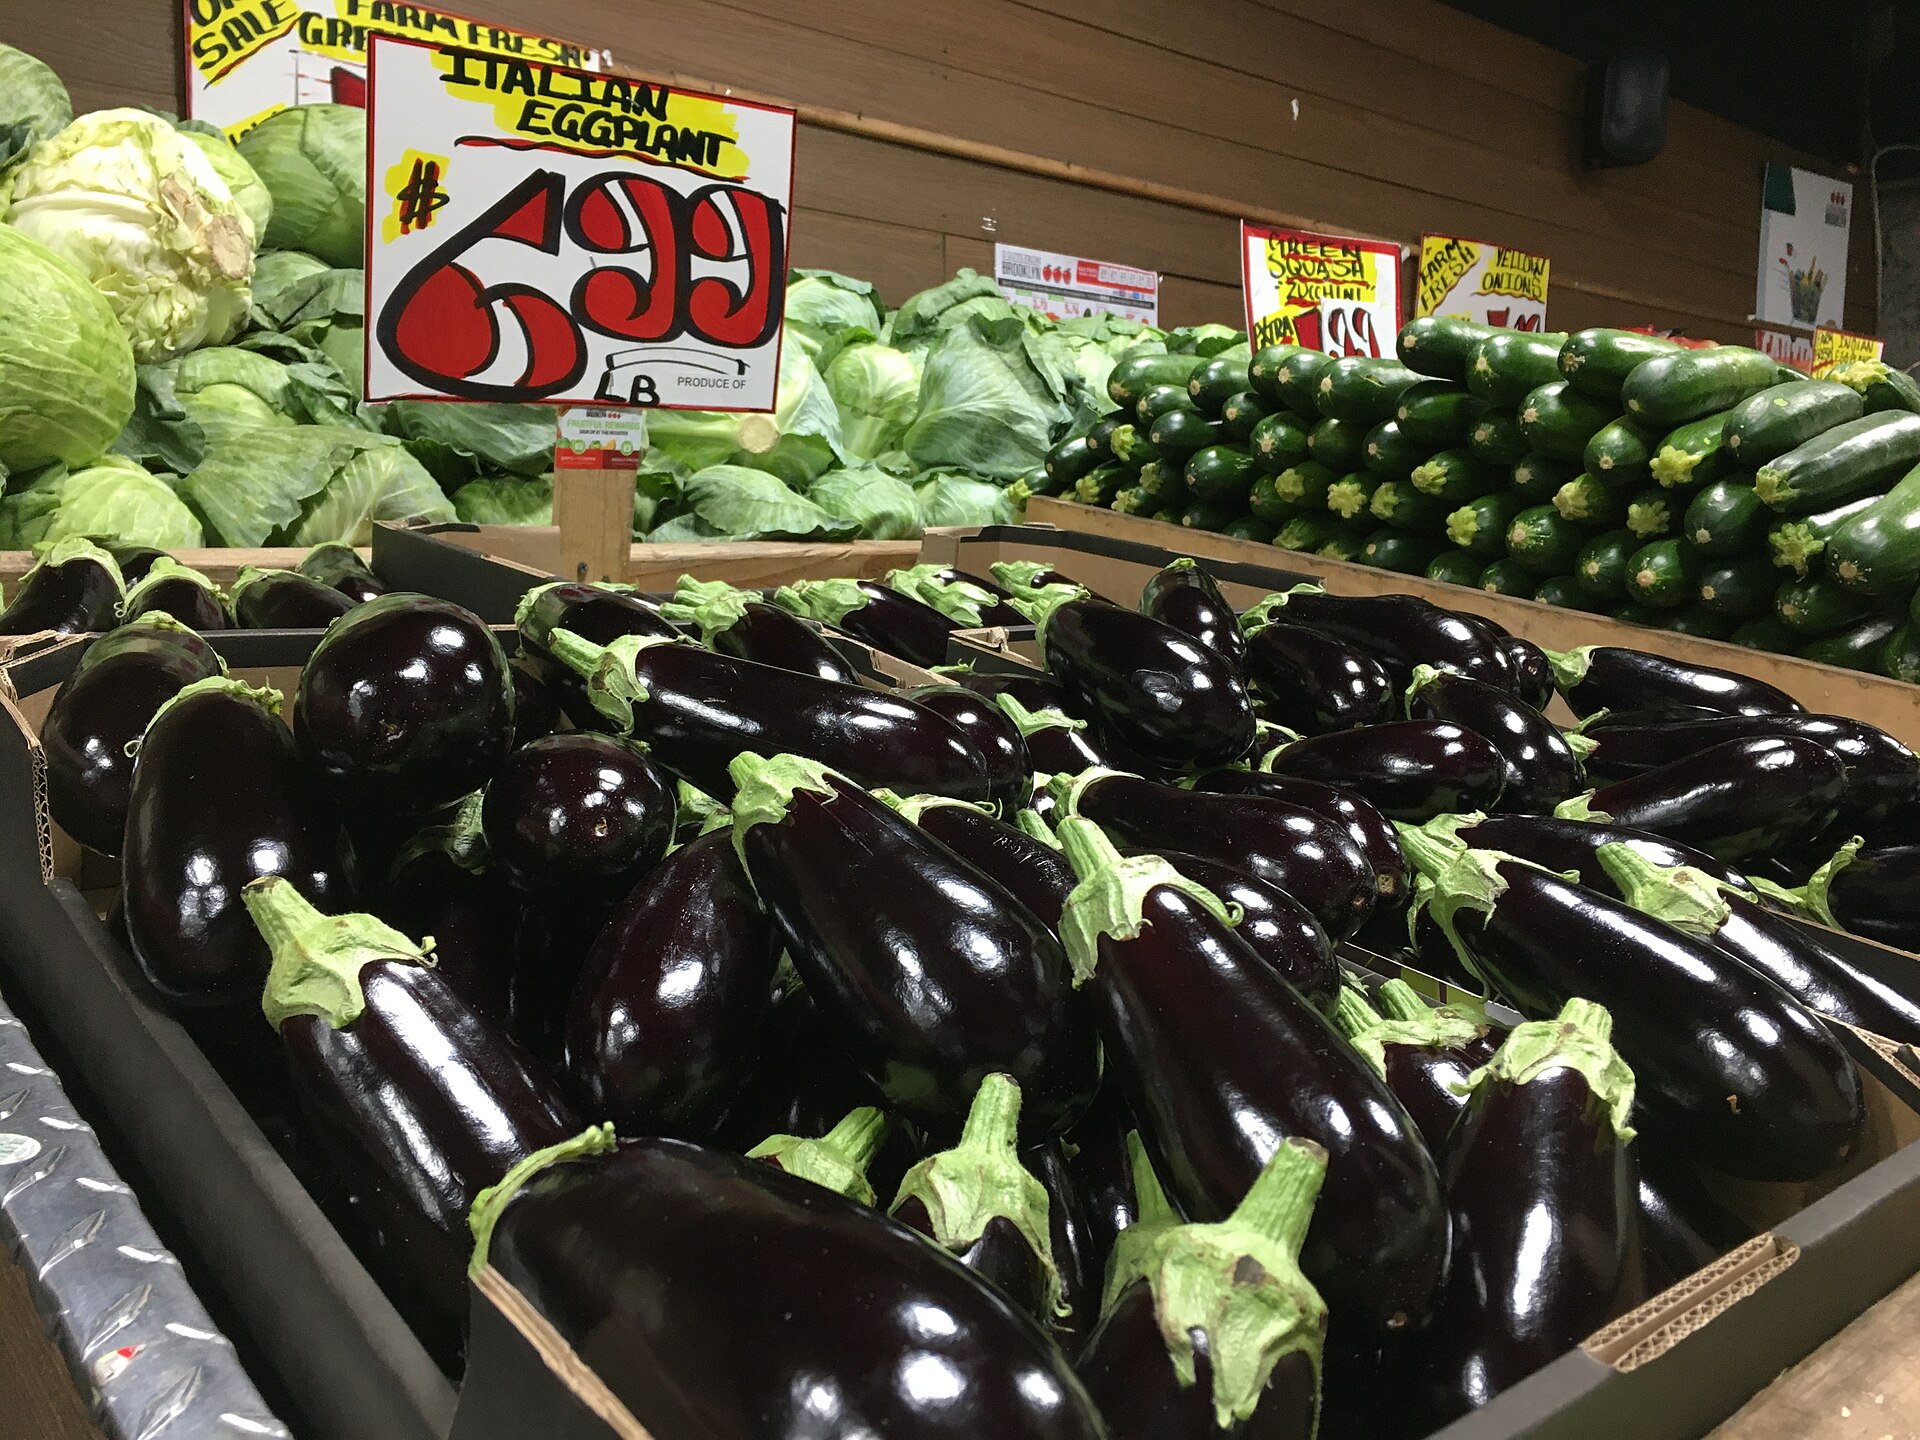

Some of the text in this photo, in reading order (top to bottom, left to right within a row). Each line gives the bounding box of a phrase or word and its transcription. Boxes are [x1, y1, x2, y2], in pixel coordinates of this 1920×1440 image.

[193, 0, 297, 70] SALE
[347, 0, 459, 39] FARM
[440, 46, 669, 121] ITALIAN
[516, 99, 736, 167] EGGPLANT
[1269, 230, 1362, 260] GREEN
[1496, 247, 1546, 276] YELLOW
[376, 167, 787, 401] 699
[1268, 254, 1364, 281] SQUASH
[1420, 246, 1475, 311] FRESH
[1482, 272, 1542, 298] ONIONS
[594, 371, 746, 407] LB PRODUCE OF
